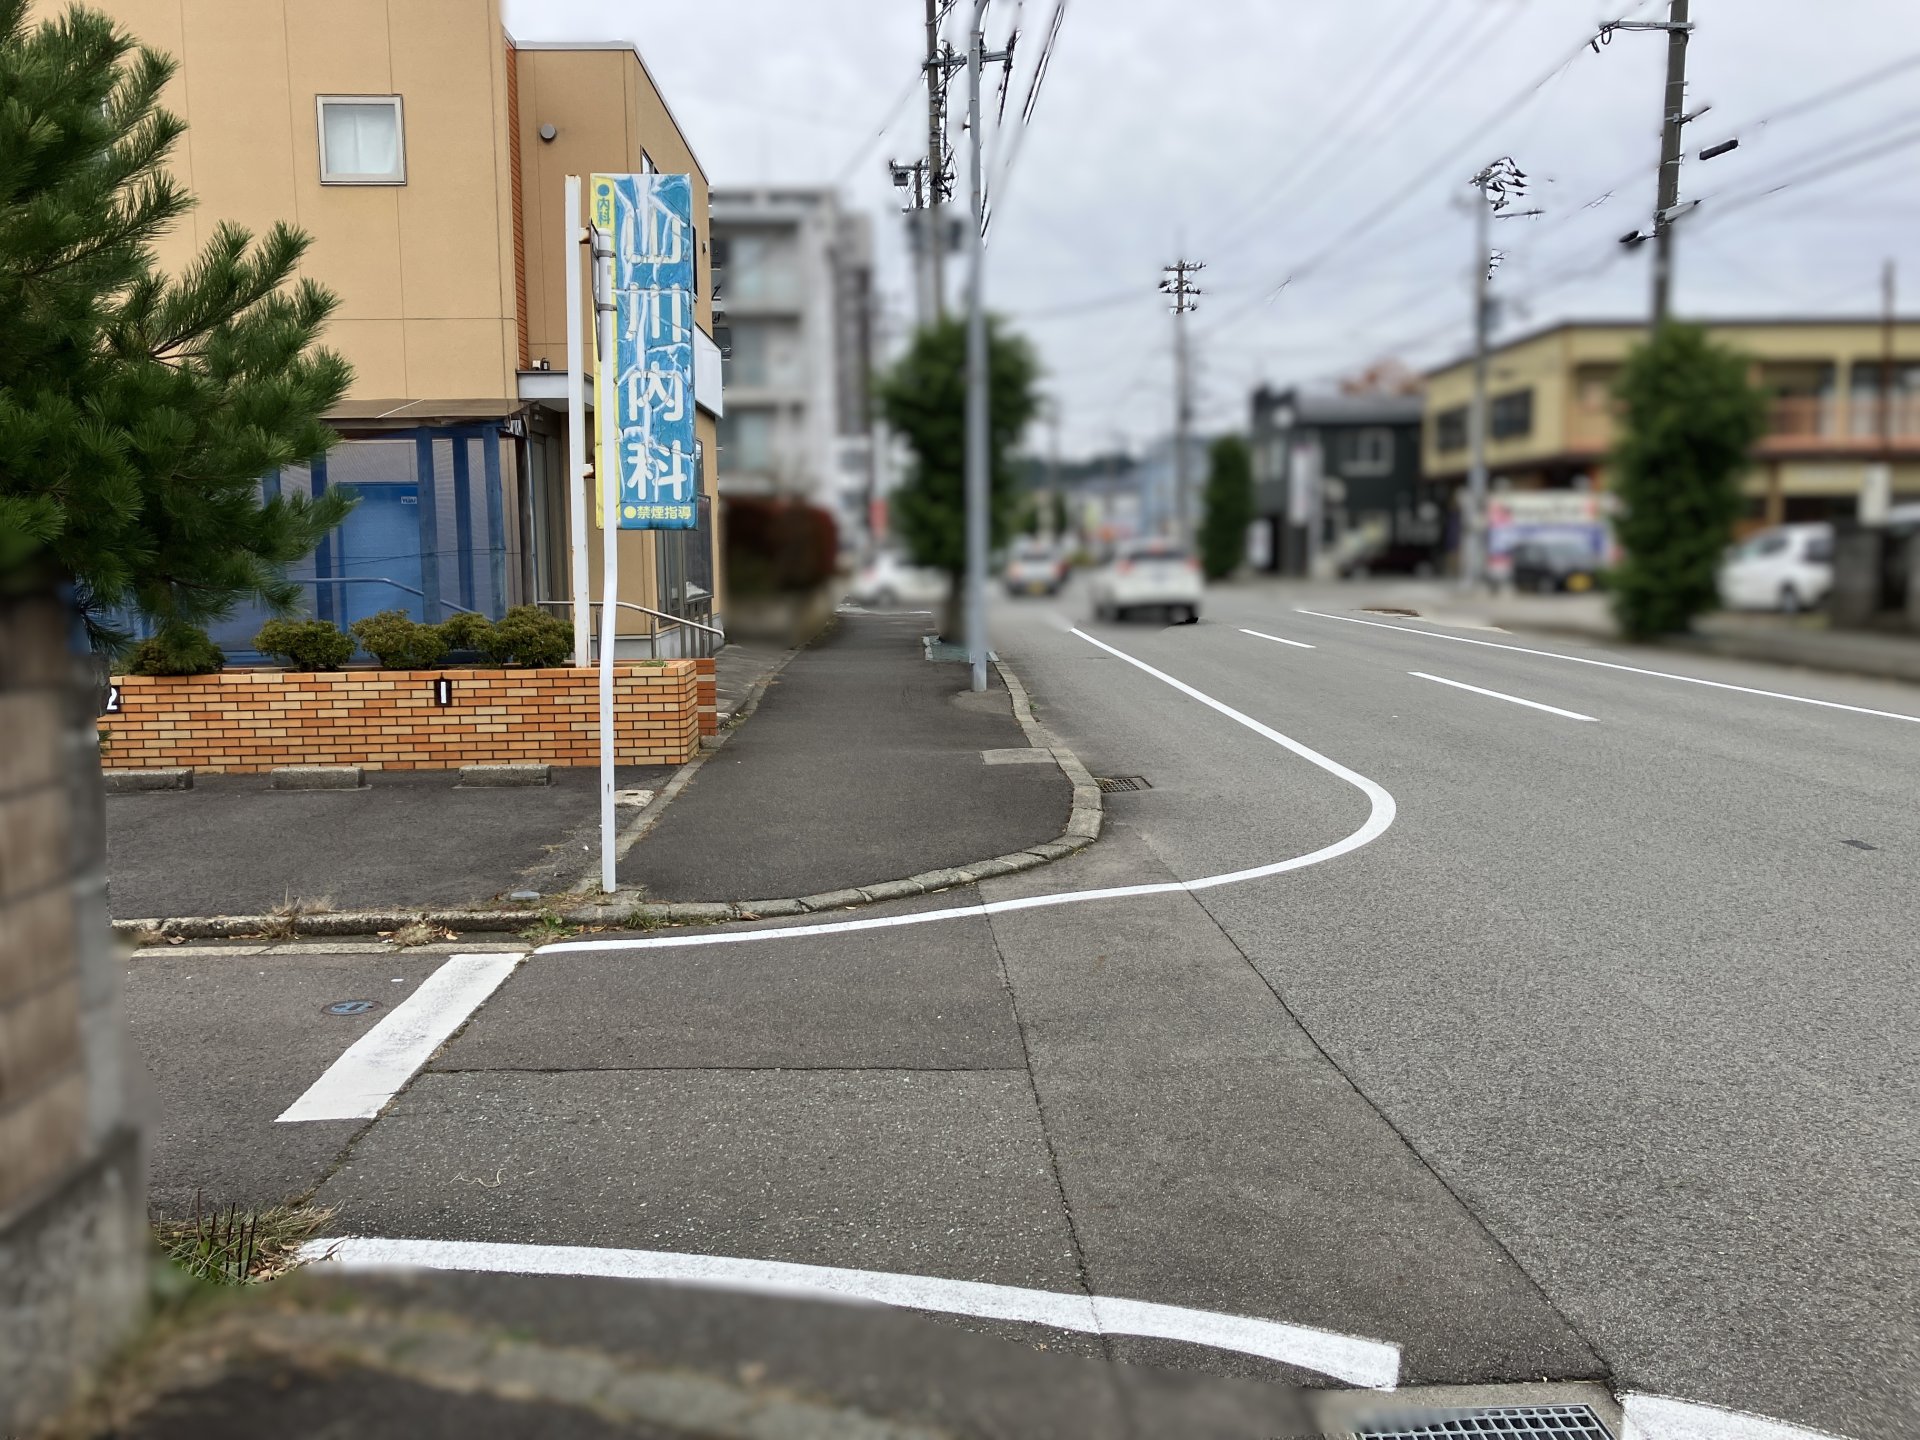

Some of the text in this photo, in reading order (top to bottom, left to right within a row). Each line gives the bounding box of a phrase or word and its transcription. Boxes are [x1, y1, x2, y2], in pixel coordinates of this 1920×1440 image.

[624, 204, 687, 500] 山川内科
[637, 505, 691, 519] 禁煙指導
[106, 687, 118, 710] 2
